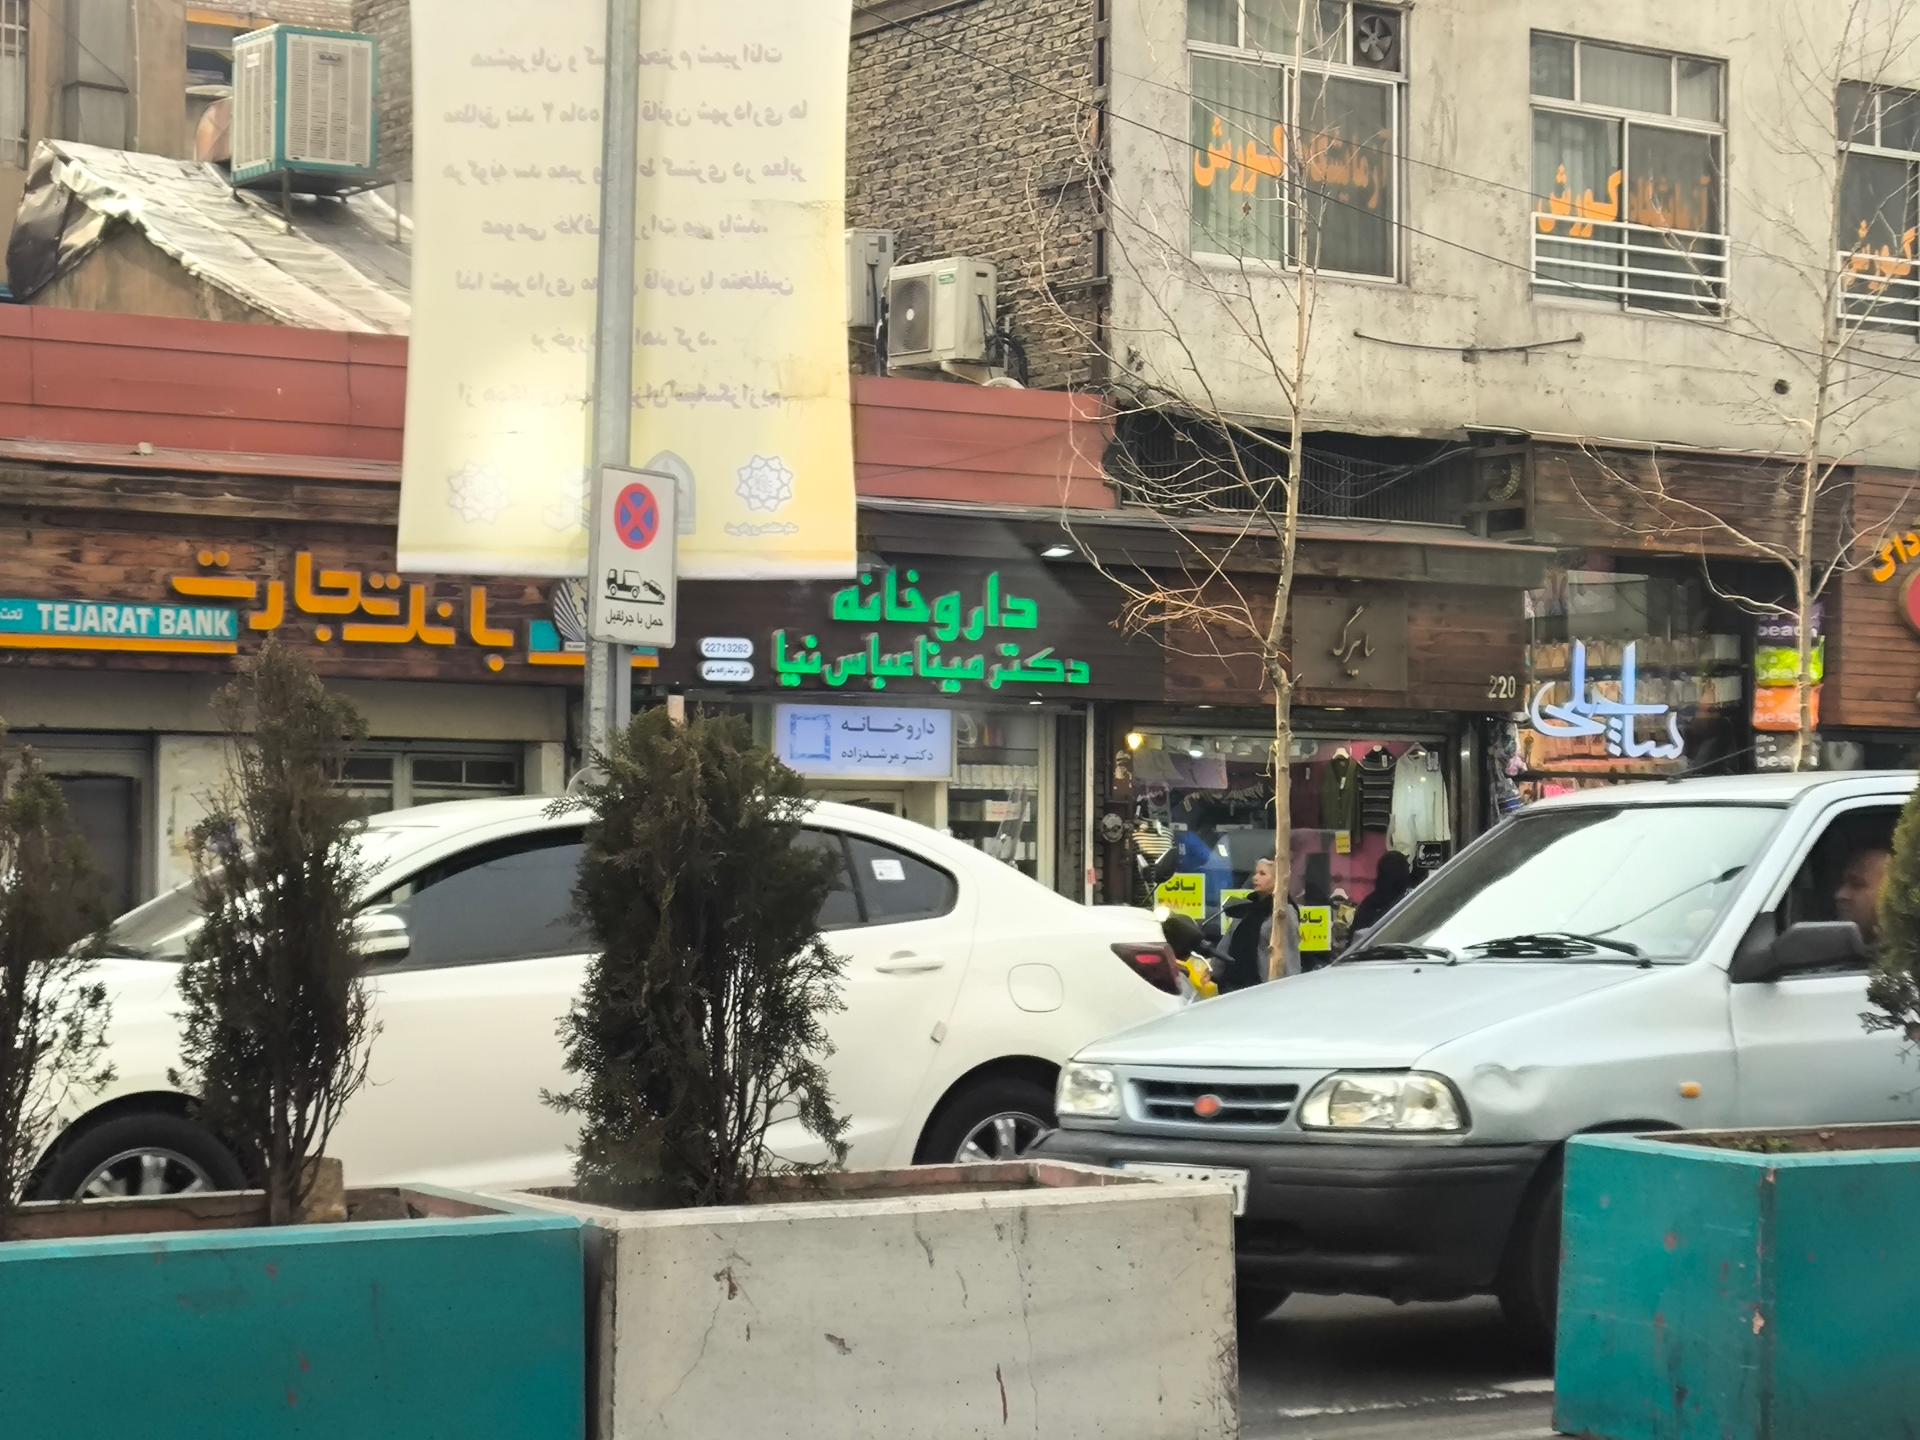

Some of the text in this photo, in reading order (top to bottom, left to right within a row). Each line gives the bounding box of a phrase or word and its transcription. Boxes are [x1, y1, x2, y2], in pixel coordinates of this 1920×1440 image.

[172, 550, 515, 672] بانک تجارت
[832, 565, 1039, 642] داروخانه
[37, 603, 232, 638] TEJARAT BANK
[605, 608, 665, 630] حمل با جرثقیل
[703, 642, 750, 655] 22713262
[987, 642, 1091, 691] دکتر
[1487, 675, 1517, 700] 220
[840, 715, 936, 741] داروخانه
[840, 747, 934, 765] دکتر مرشدزاده
[1165, 877, 1196, 895] بافت
[1300, 910, 1323, 927] باف
